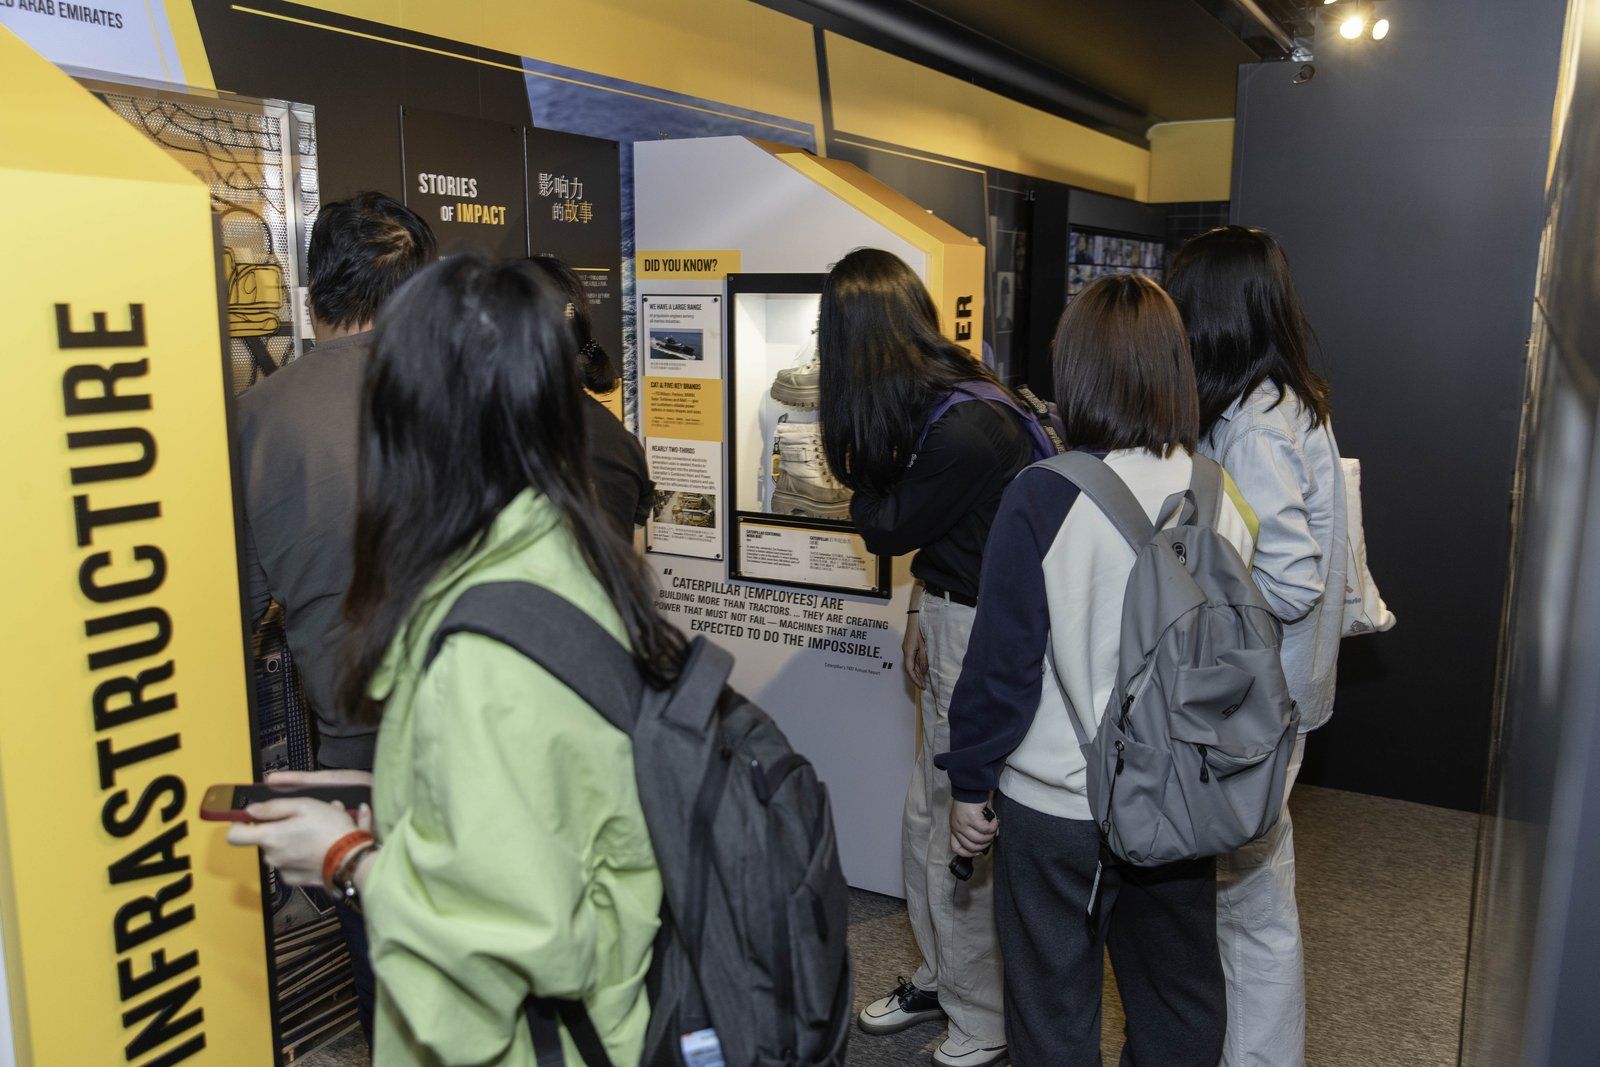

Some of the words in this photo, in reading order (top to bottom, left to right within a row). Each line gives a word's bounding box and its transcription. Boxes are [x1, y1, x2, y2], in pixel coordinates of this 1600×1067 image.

[19, 0, 55, 16] ARAB
[58, 2, 123, 29] EMIRATES
[417, 172, 478, 198] STORIES
[537, 173, 584, 200] 影响力
[440, 205, 454, 222] OF
[456, 202, 506, 225] IMPACT
[551, 199, 594, 224] 的故事
[644, 259, 660, 272] DID
[662, 259, 681, 272] YOU
[683, 259, 718, 272] KNOW?
[659, 589, 695, 602] BUILDING
[697, 595, 720, 606] MORE
[723, 598, 746, 610] THAN
[749, 602, 791, 616] TRACTORS.
[803, 610, 824, 621] THEY
[826, 613, 843, 624] ARE
[846, 616, 889, 630] CREATING
[744, 585, 818, 609] [EMPLOYEES]
[820, 596, 845, 611] ARE
[654, 601, 681, 612] POWER
[684, 605, 703, 615] THAT
[705, 608, 728, 619] MUST
[730, 612, 747, 622] NOT
[826, 626, 848, 637] THAT
[850, 629, 867, 640] ARE
[691, 619, 743, 637] EXPECTED
[747, 627, 760, 640] TO
[764, 630, 779, 643] DO
[783, 632, 804, 647] THE
[54, 303, 206, 1067] INFRASTRUCTURE
